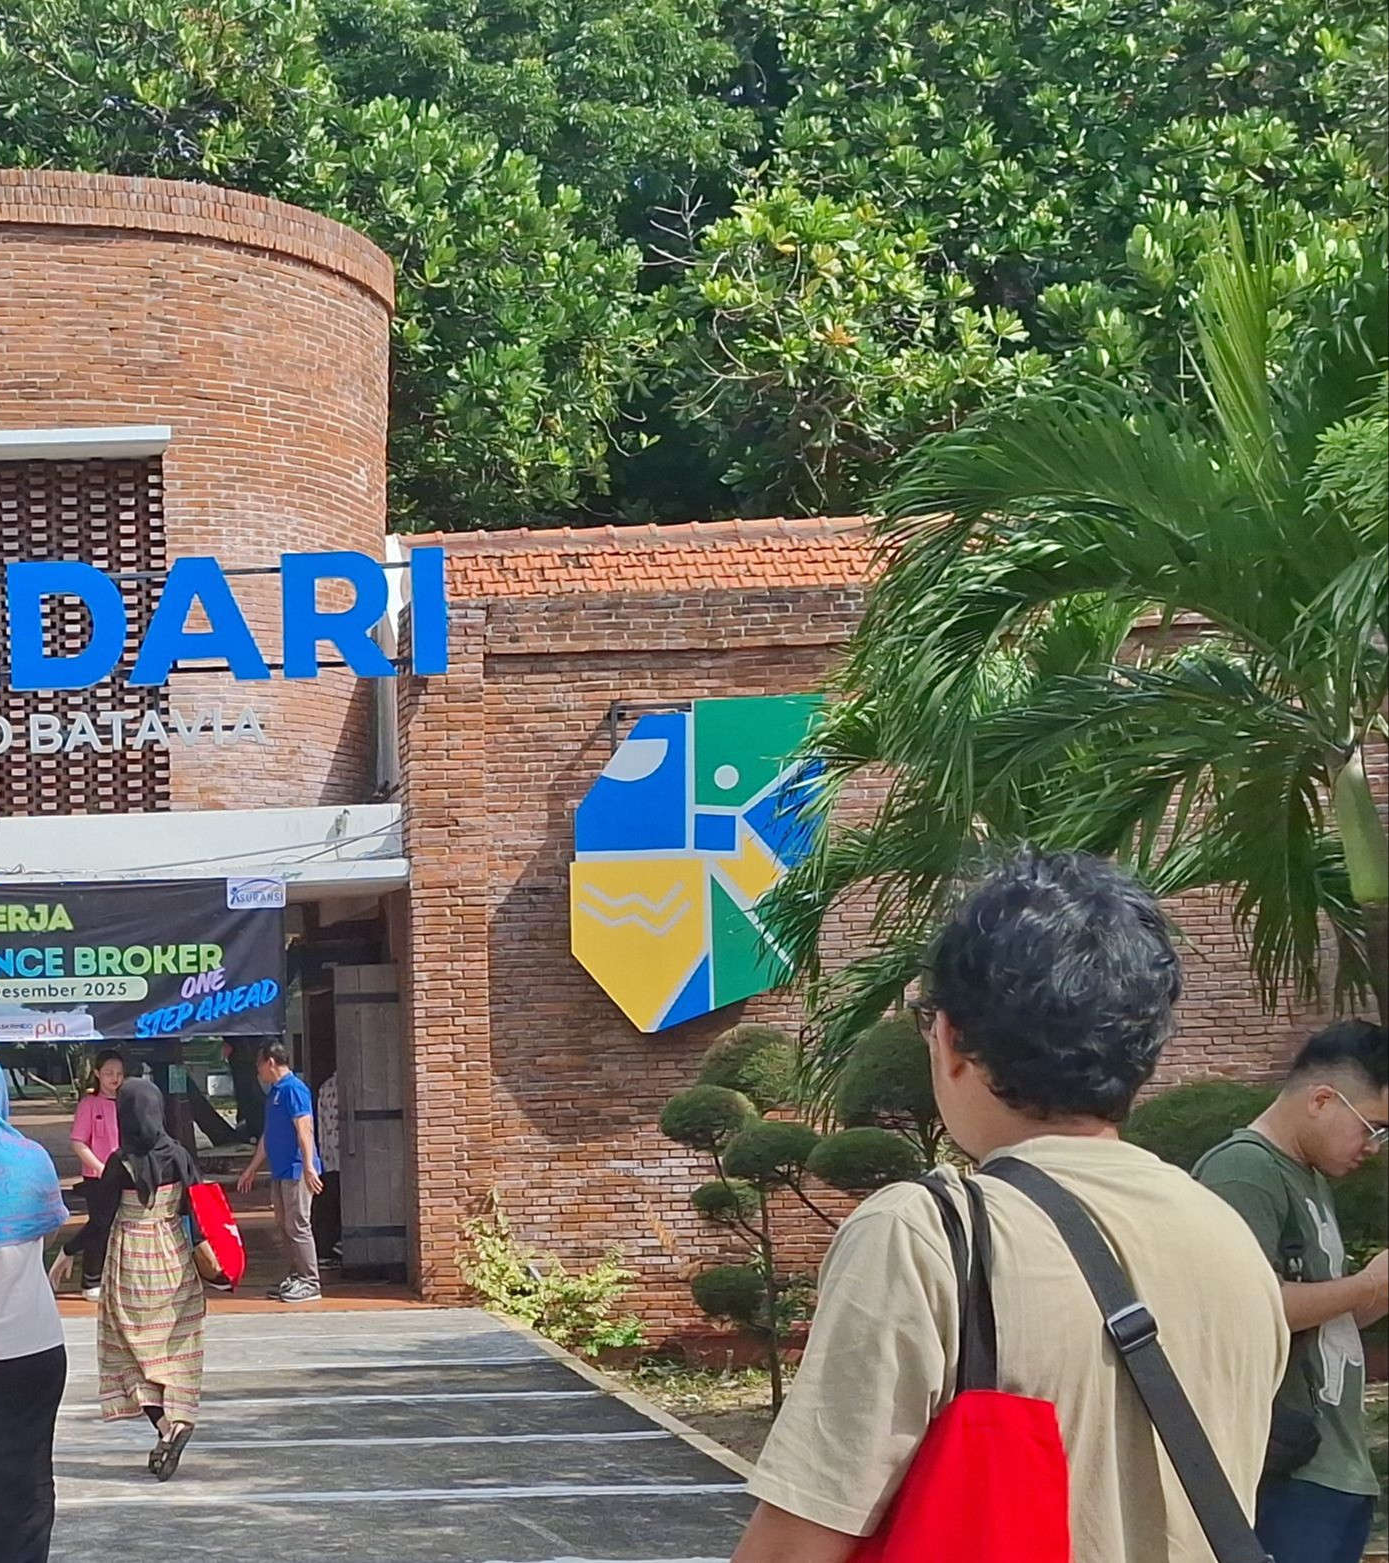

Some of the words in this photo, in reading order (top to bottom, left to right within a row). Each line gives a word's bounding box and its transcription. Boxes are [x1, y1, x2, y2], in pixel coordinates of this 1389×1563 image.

[29, 706, 270, 754] BATAVIA
[74, 944, 223, 975] BROKER
[83, 982, 127, 996] 2025
[181, 967, 226, 998] ONE
[135, 1002, 194, 1039] STEP
[195, 978, 279, 1021] AHEAD
